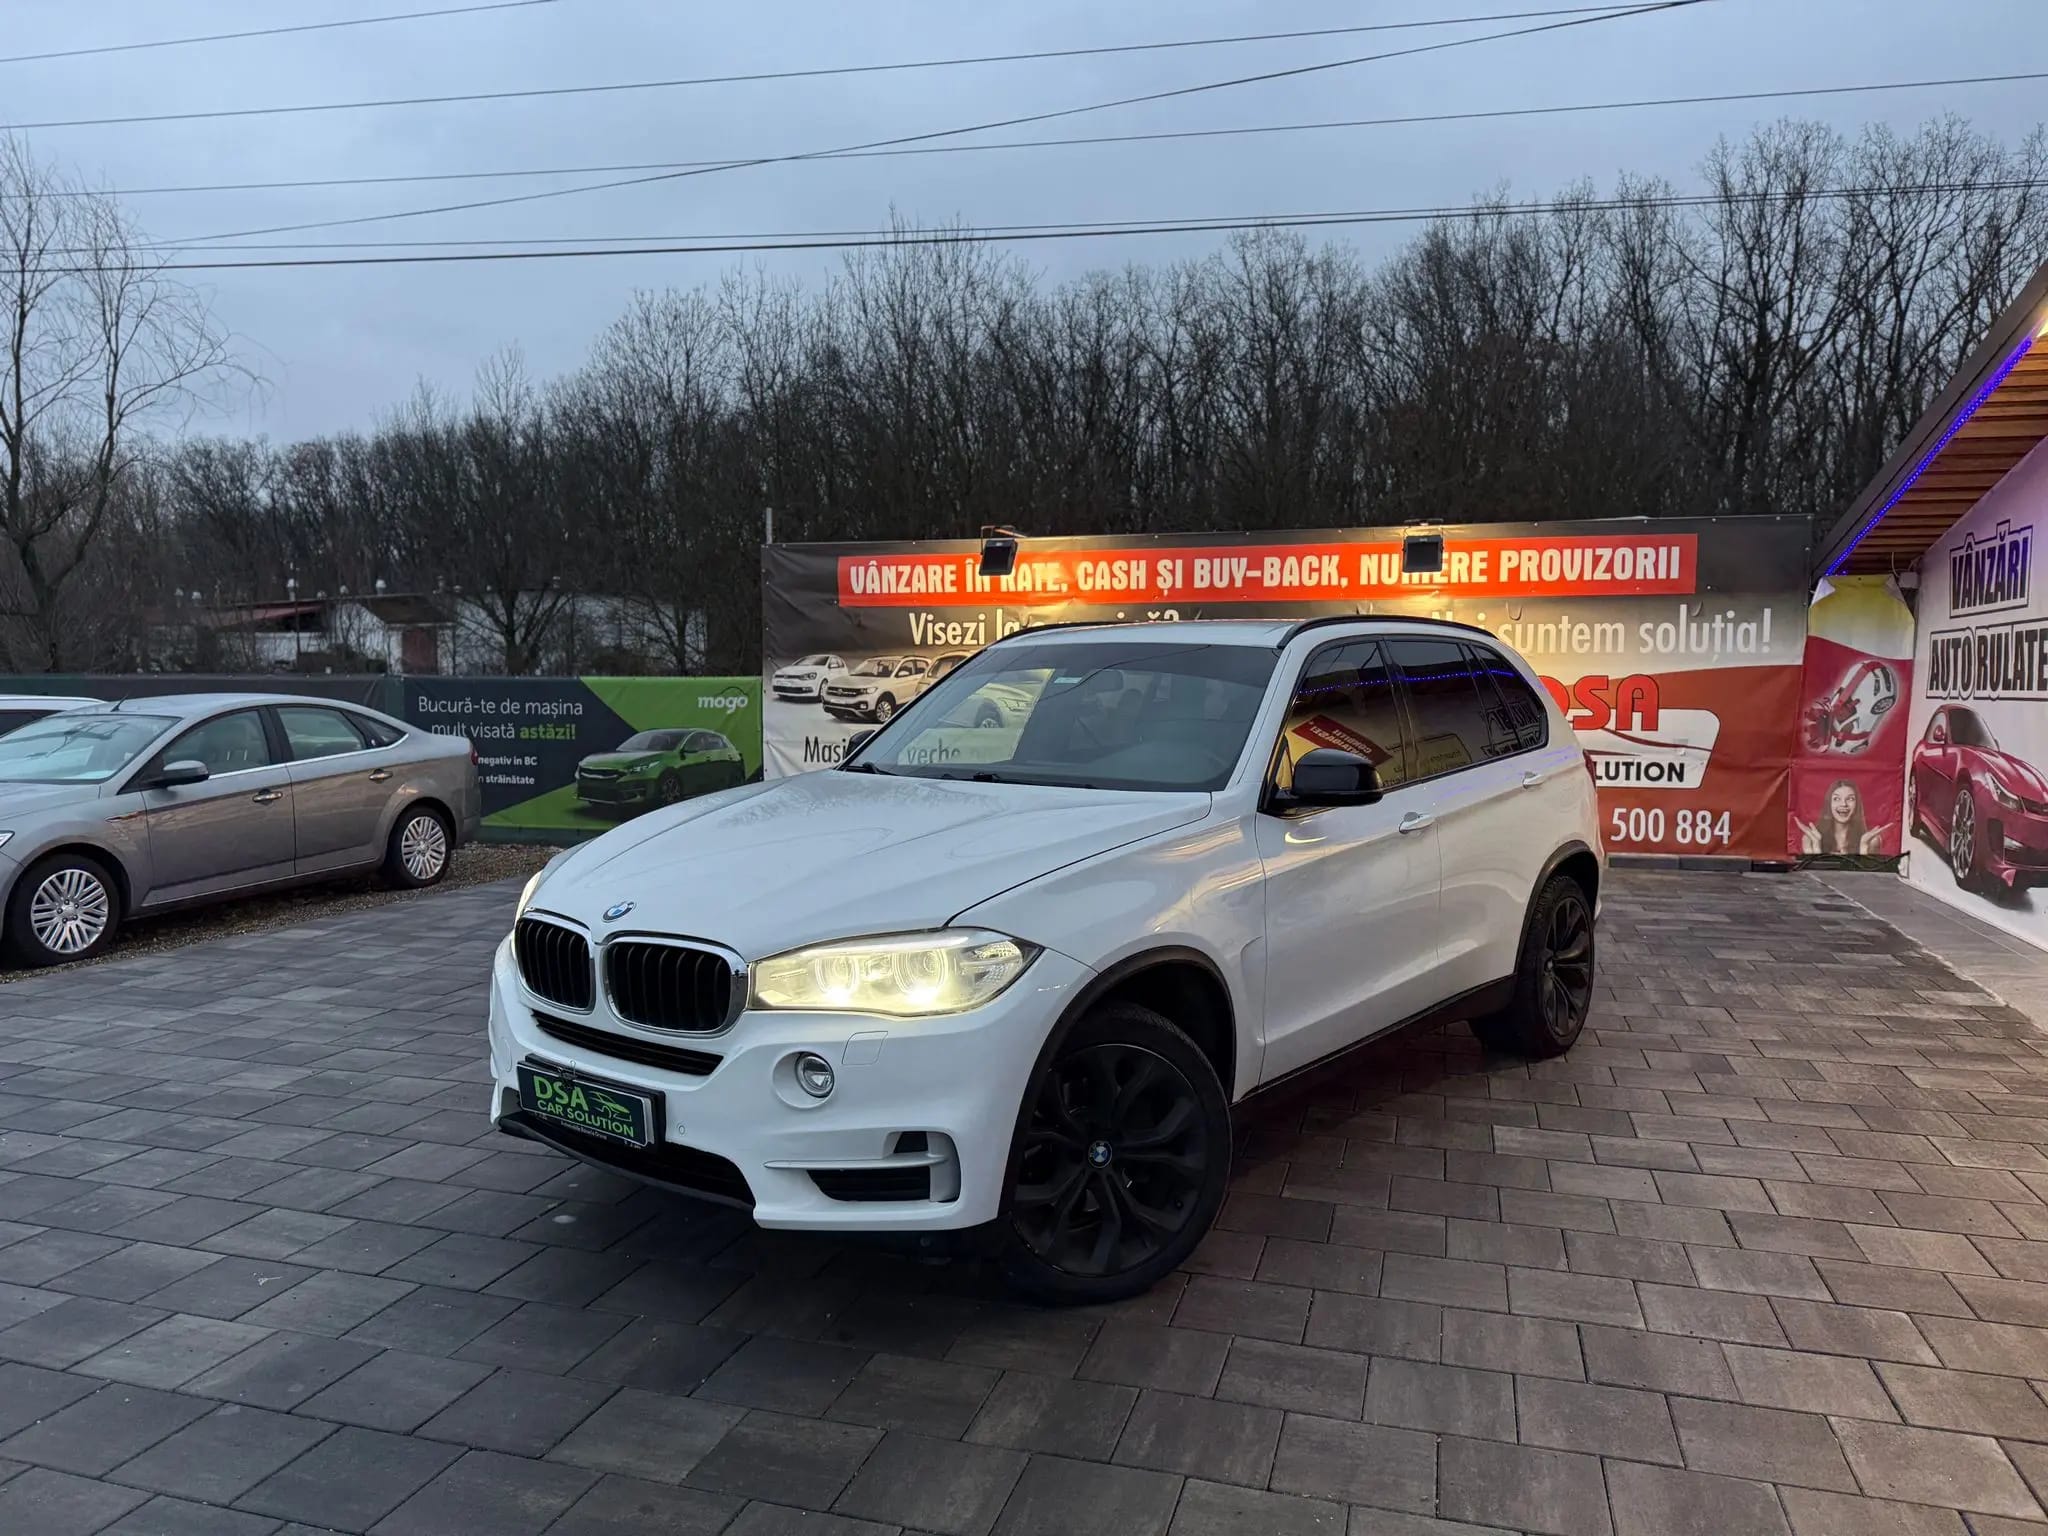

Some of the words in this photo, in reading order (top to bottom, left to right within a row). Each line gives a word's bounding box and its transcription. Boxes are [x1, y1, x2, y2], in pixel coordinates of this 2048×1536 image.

[850, 560, 958, 594] VÂNZARE
[1000, 563, 1069, 593] RATE,
[1077, 559, 1147, 591] CASH
[1156, 559, 1183, 597] ȘI
[1193, 554, 1348, 589] BUY-BACK,
[1359, 551, 1489, 586] NUERE
[1499, 546, 1681, 582] PROVIZORII
[1952, 531, 2029, 610] VÂNZĂRI
[908, 612, 986, 645] Visezi
[1498, 614, 1626, 654] suntem
[1639, 603, 1772, 662] soluția!
[1929, 635, 1973, 692] AUTO
[1976, 628, 2048, 692] RULATE
[418, 696, 496, 714] Bucură-te
[500, 698, 521, 714] de
[525, 698, 583, 718] mașina
[697, 696, 749, 714] mogo
[432, 722, 467, 737] mult
[470, 722, 515, 739] visată
[519, 723, 576, 740] astăzi!
[478, 755, 512, 767] negativ
[524, 756, 538, 766] BC
[1593, 761, 1686, 783] LUTION
[1610, 807, 1665, 843] 500
[1676, 809, 1732, 845] 884
[533, 1074, 589, 1111] DSA
[537, 1099, 564, 1118] CAR
[567, 1107, 635, 1138] SOLUTION
